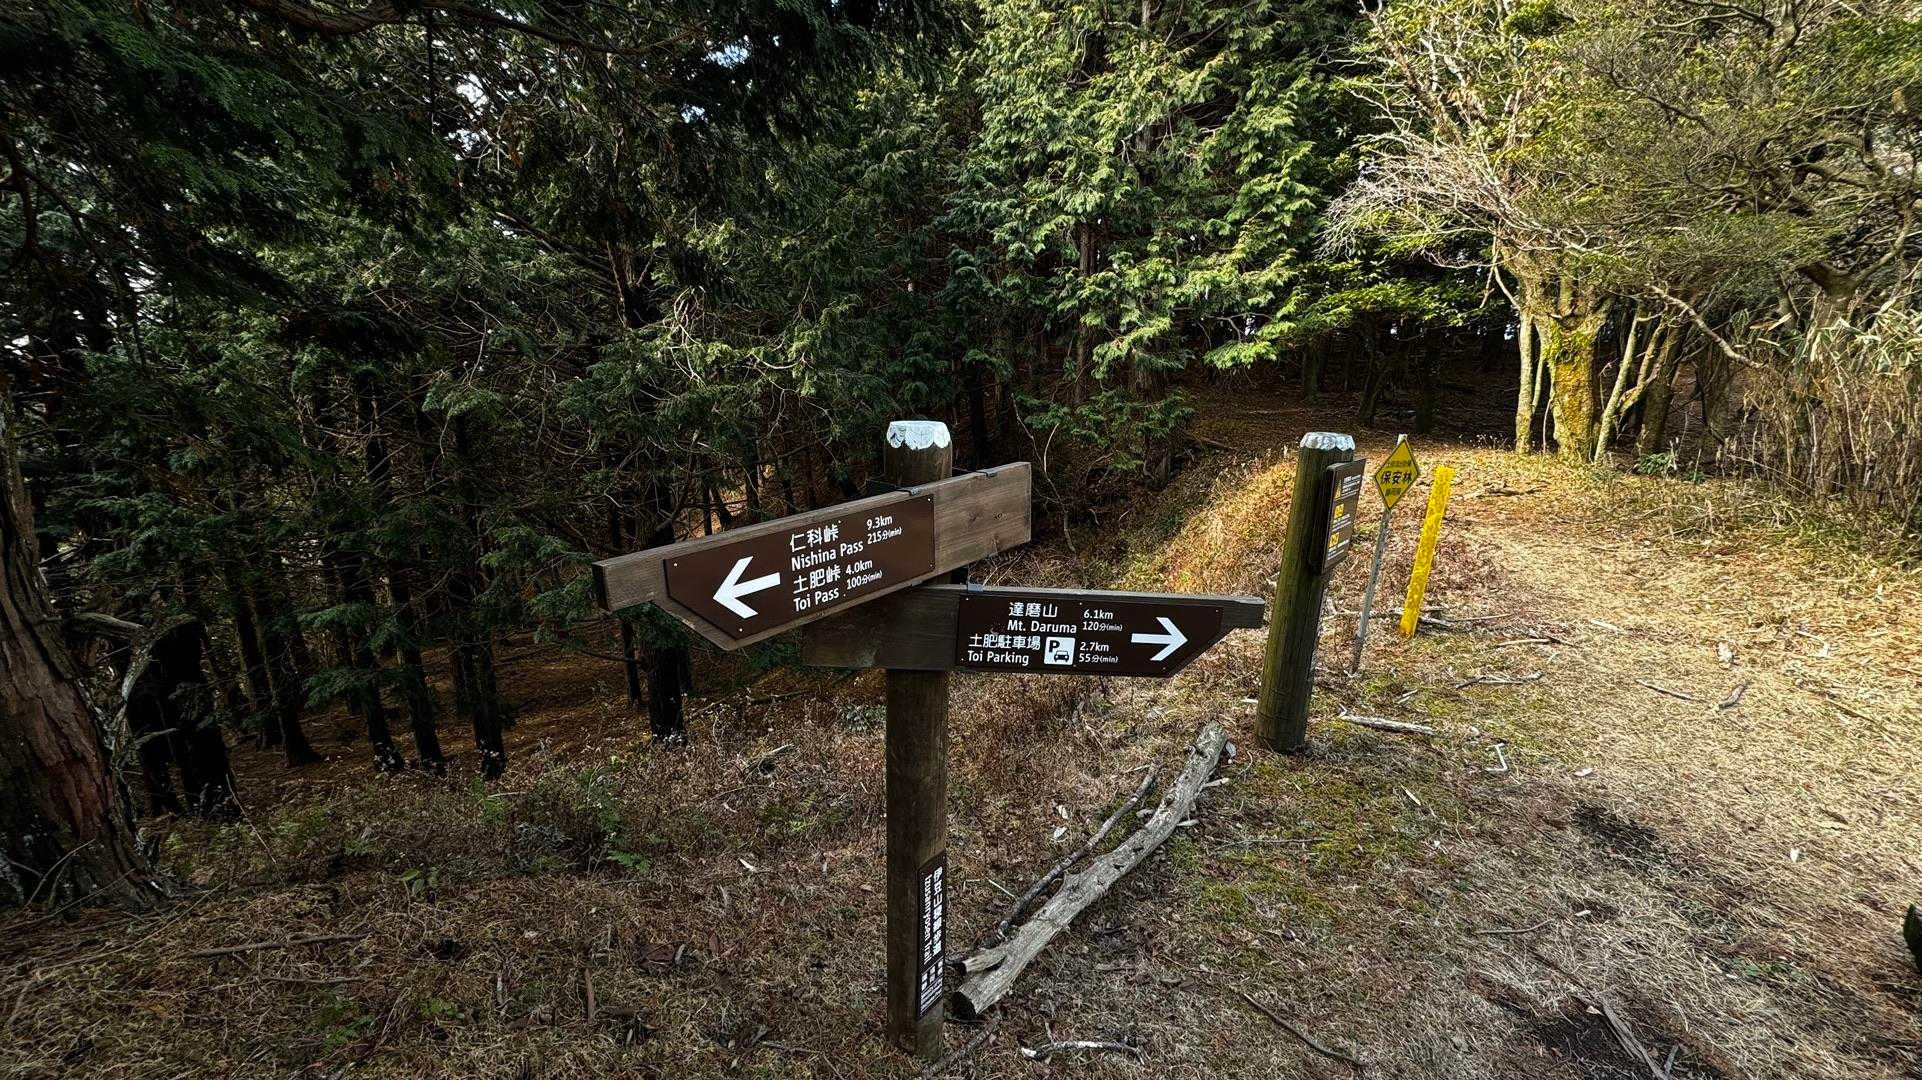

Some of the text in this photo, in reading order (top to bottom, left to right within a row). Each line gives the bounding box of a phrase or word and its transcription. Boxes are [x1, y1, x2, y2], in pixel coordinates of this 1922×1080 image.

[866, 515, 893, 531] 9.3km
[789, 524, 839, 552] 仁科峠
[791, 541, 864, 571] Nishina Pass
[845, 560, 873, 575] 4.0km
[793, 564, 841, 595] 土肥峠
[793, 587, 839, 612] Toi Pass
[1008, 602, 1058, 618] 達磨山
[1083, 609, 1114, 620] 6.1km
[1007, 620, 1077, 634] Mt. Daruma
[968, 633, 1041, 651] 土肥駐車場
[1050, 640, 1060, 653] P
[1080, 641, 1110, 652] 2.7km
[968, 650, 1030, 666] Toi Parking
